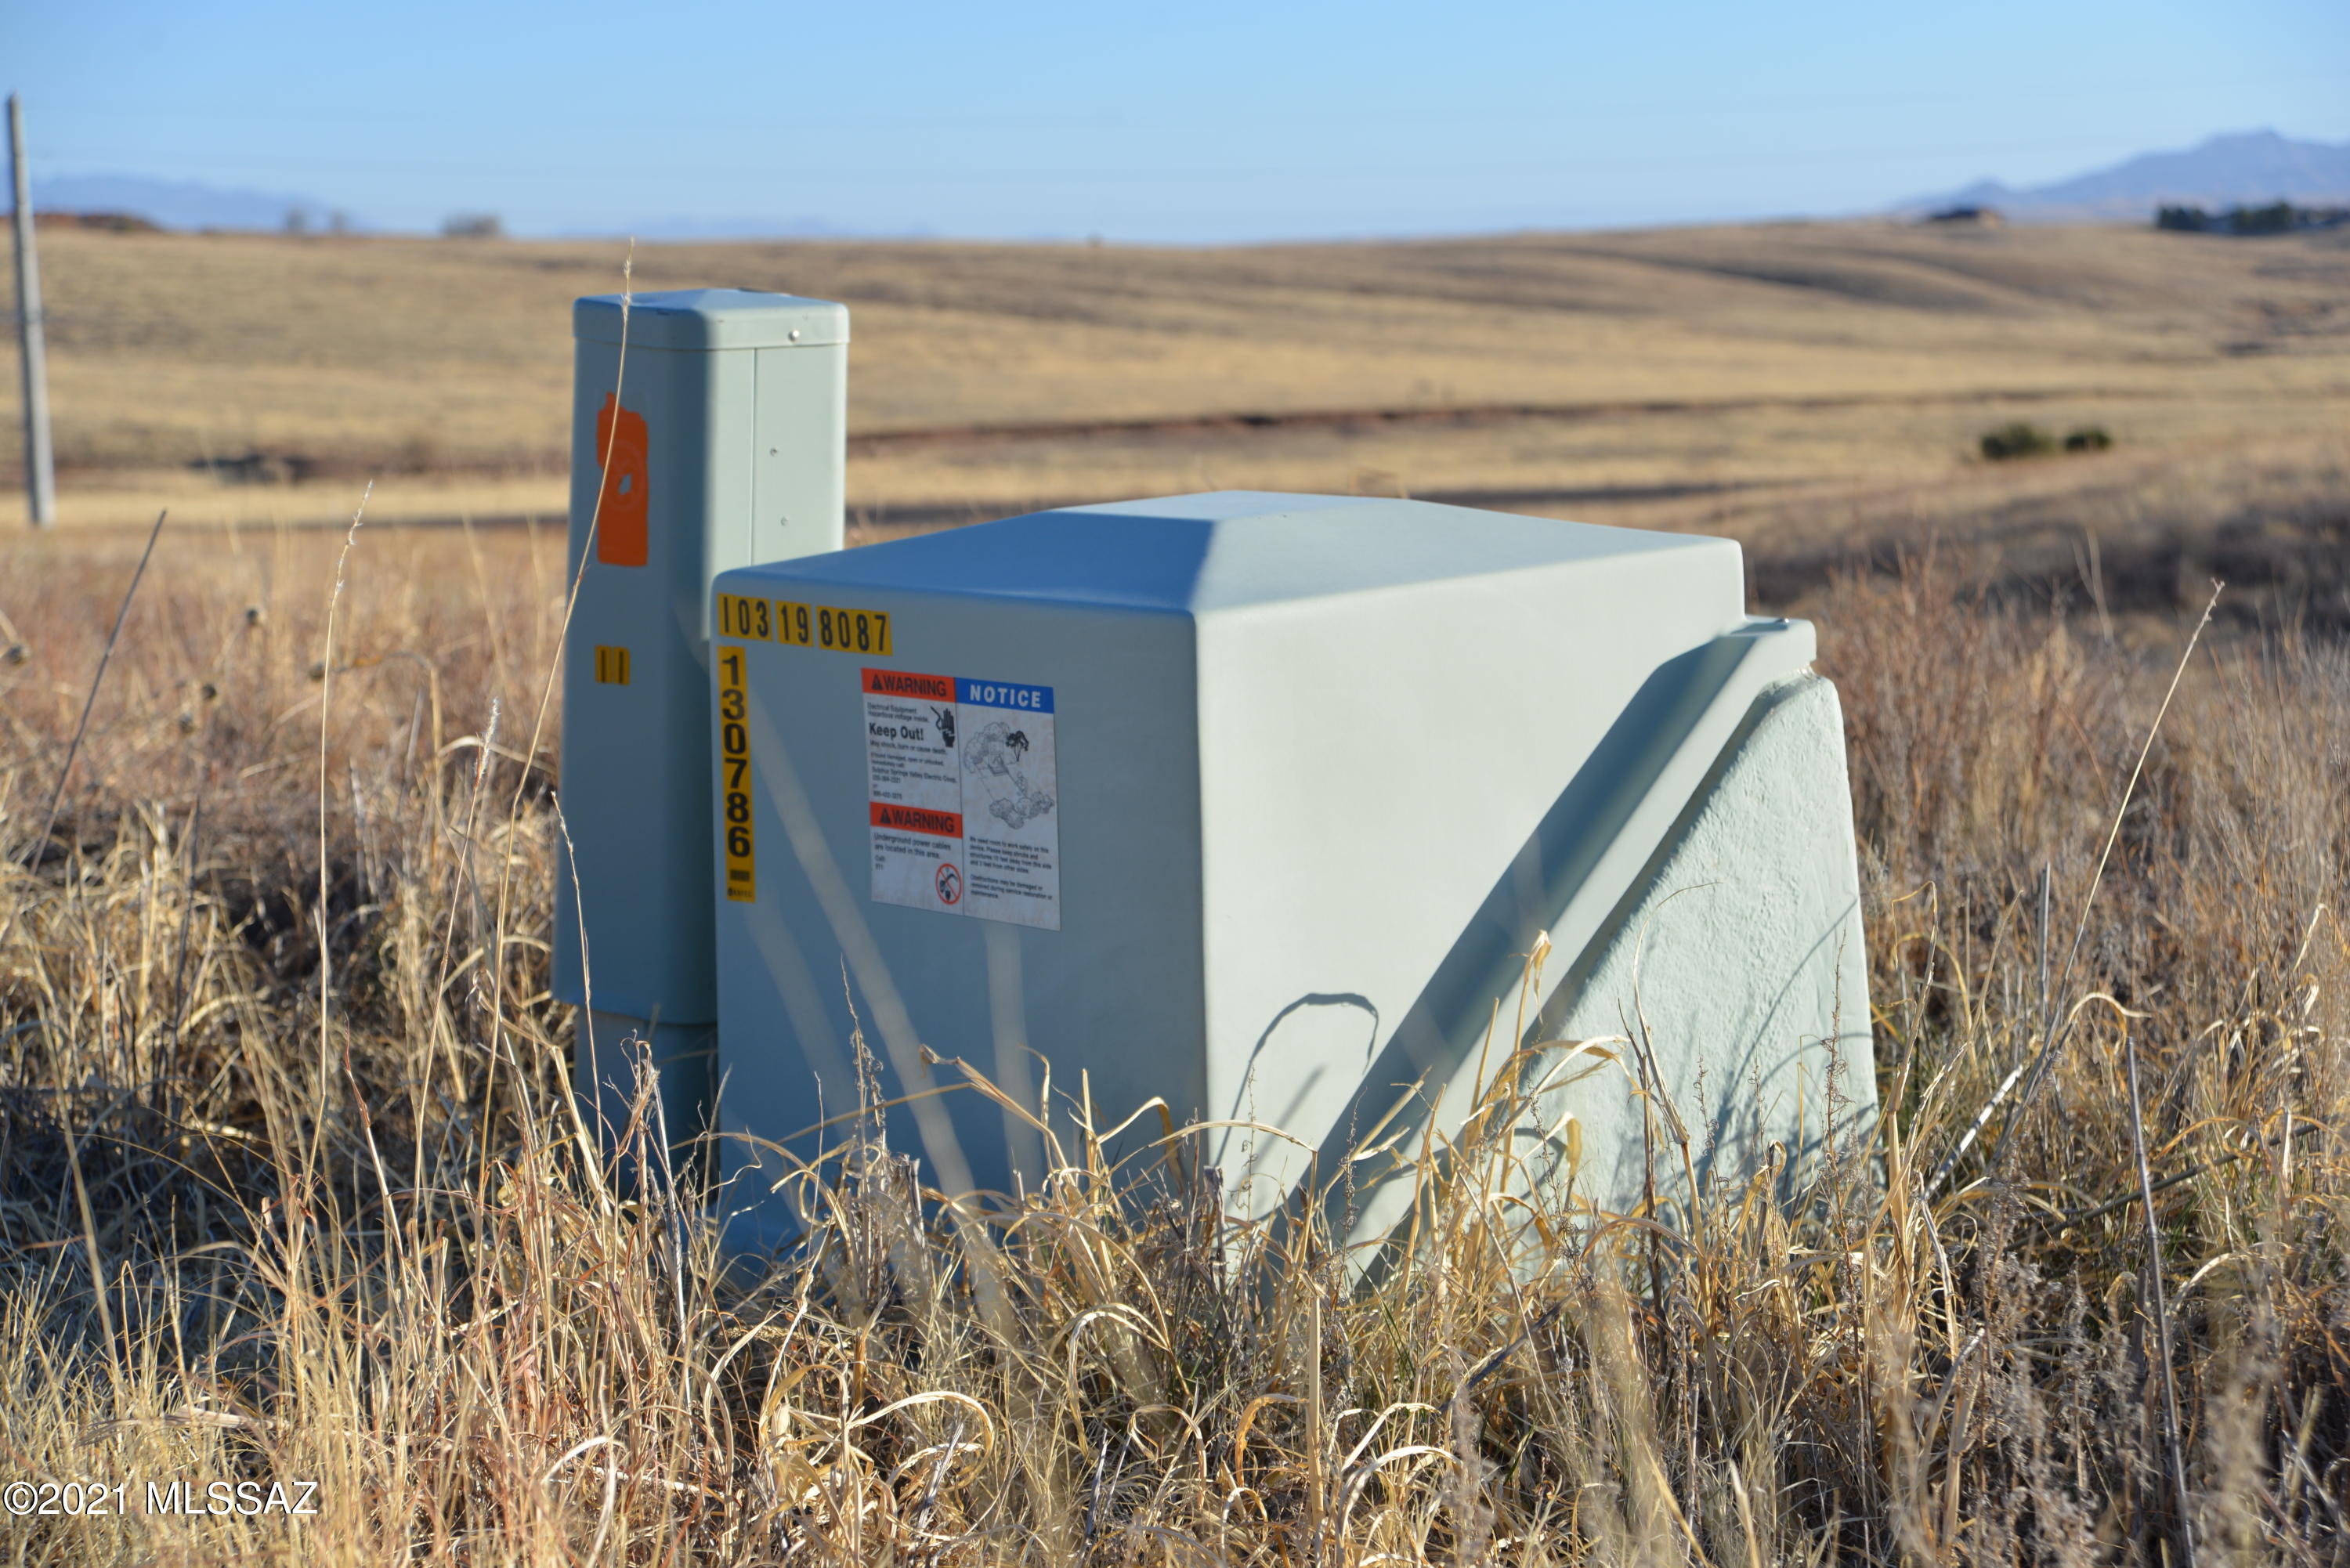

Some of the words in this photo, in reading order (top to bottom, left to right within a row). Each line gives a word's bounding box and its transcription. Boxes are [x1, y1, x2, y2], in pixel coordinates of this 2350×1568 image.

[781, 605, 809, 643] 19
[819, 609, 886, 652] 8087
[883, 674, 947, 697] WARNING
[970, 684, 1041, 708] NOTICE
[869, 722, 897, 740] Keep
[900, 725, 924, 741] Out!
[721, 655, 751, 858] 130786
[891, 808, 955, 833] WARNING
[874, 833, 911, 844] Underground
[913, 839, 931, 847] power
[931, 840, 952, 851] cables
[884, 844, 906, 854] located
[914, 847, 925, 857] this
